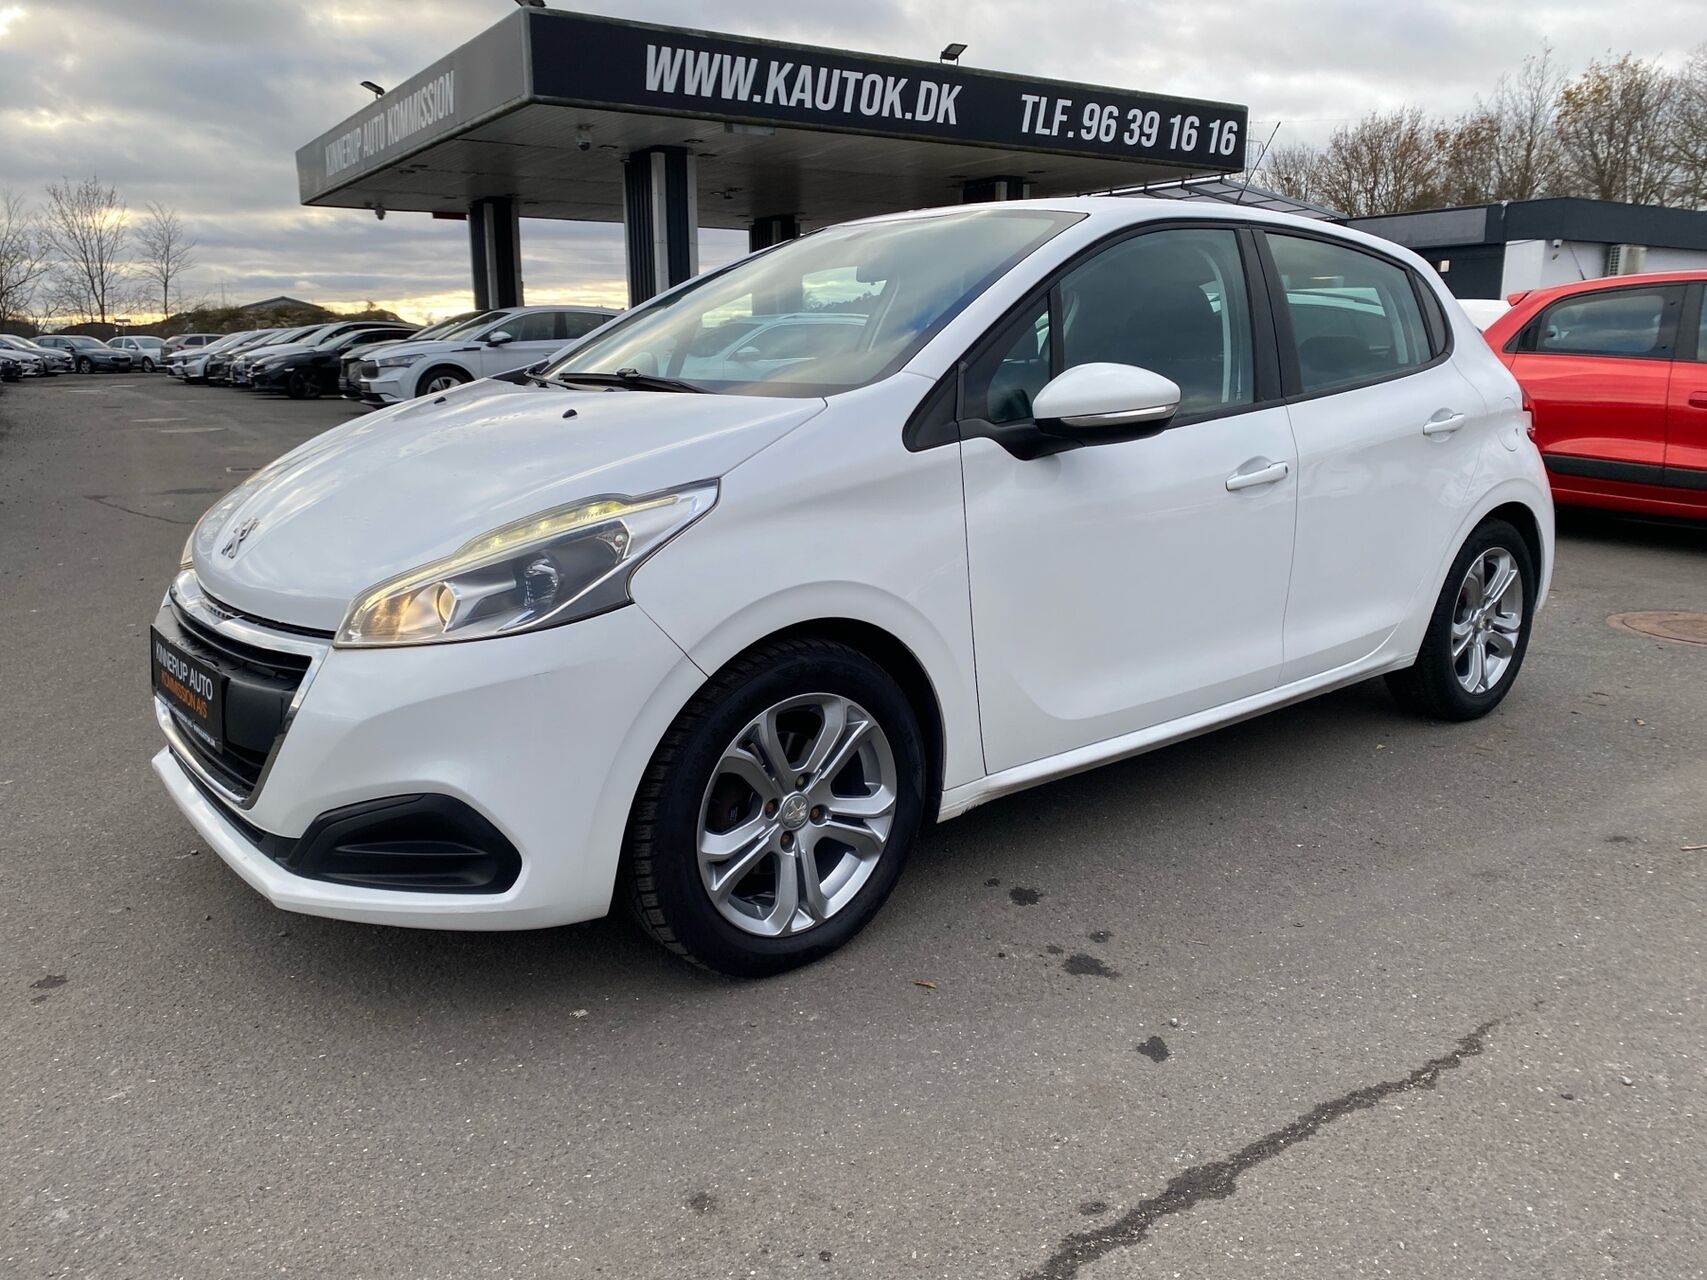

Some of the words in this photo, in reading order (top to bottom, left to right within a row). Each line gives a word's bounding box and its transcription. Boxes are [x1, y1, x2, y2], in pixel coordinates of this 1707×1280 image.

[363, 113, 384, 159] AUTO
[387, 70, 454, 146] KOMMISSION
[645, 44, 962, 125] WWW.KAUTOK.DK
[1021, 94, 1074, 138] TLF.
[1080, 103, 1117, 143] 96
[1123, 108, 1160, 148] 39
[1170, 114, 1199, 152] 16
[1208, 119, 1238, 156] 16
[189, 668, 213, 700] AUTO
